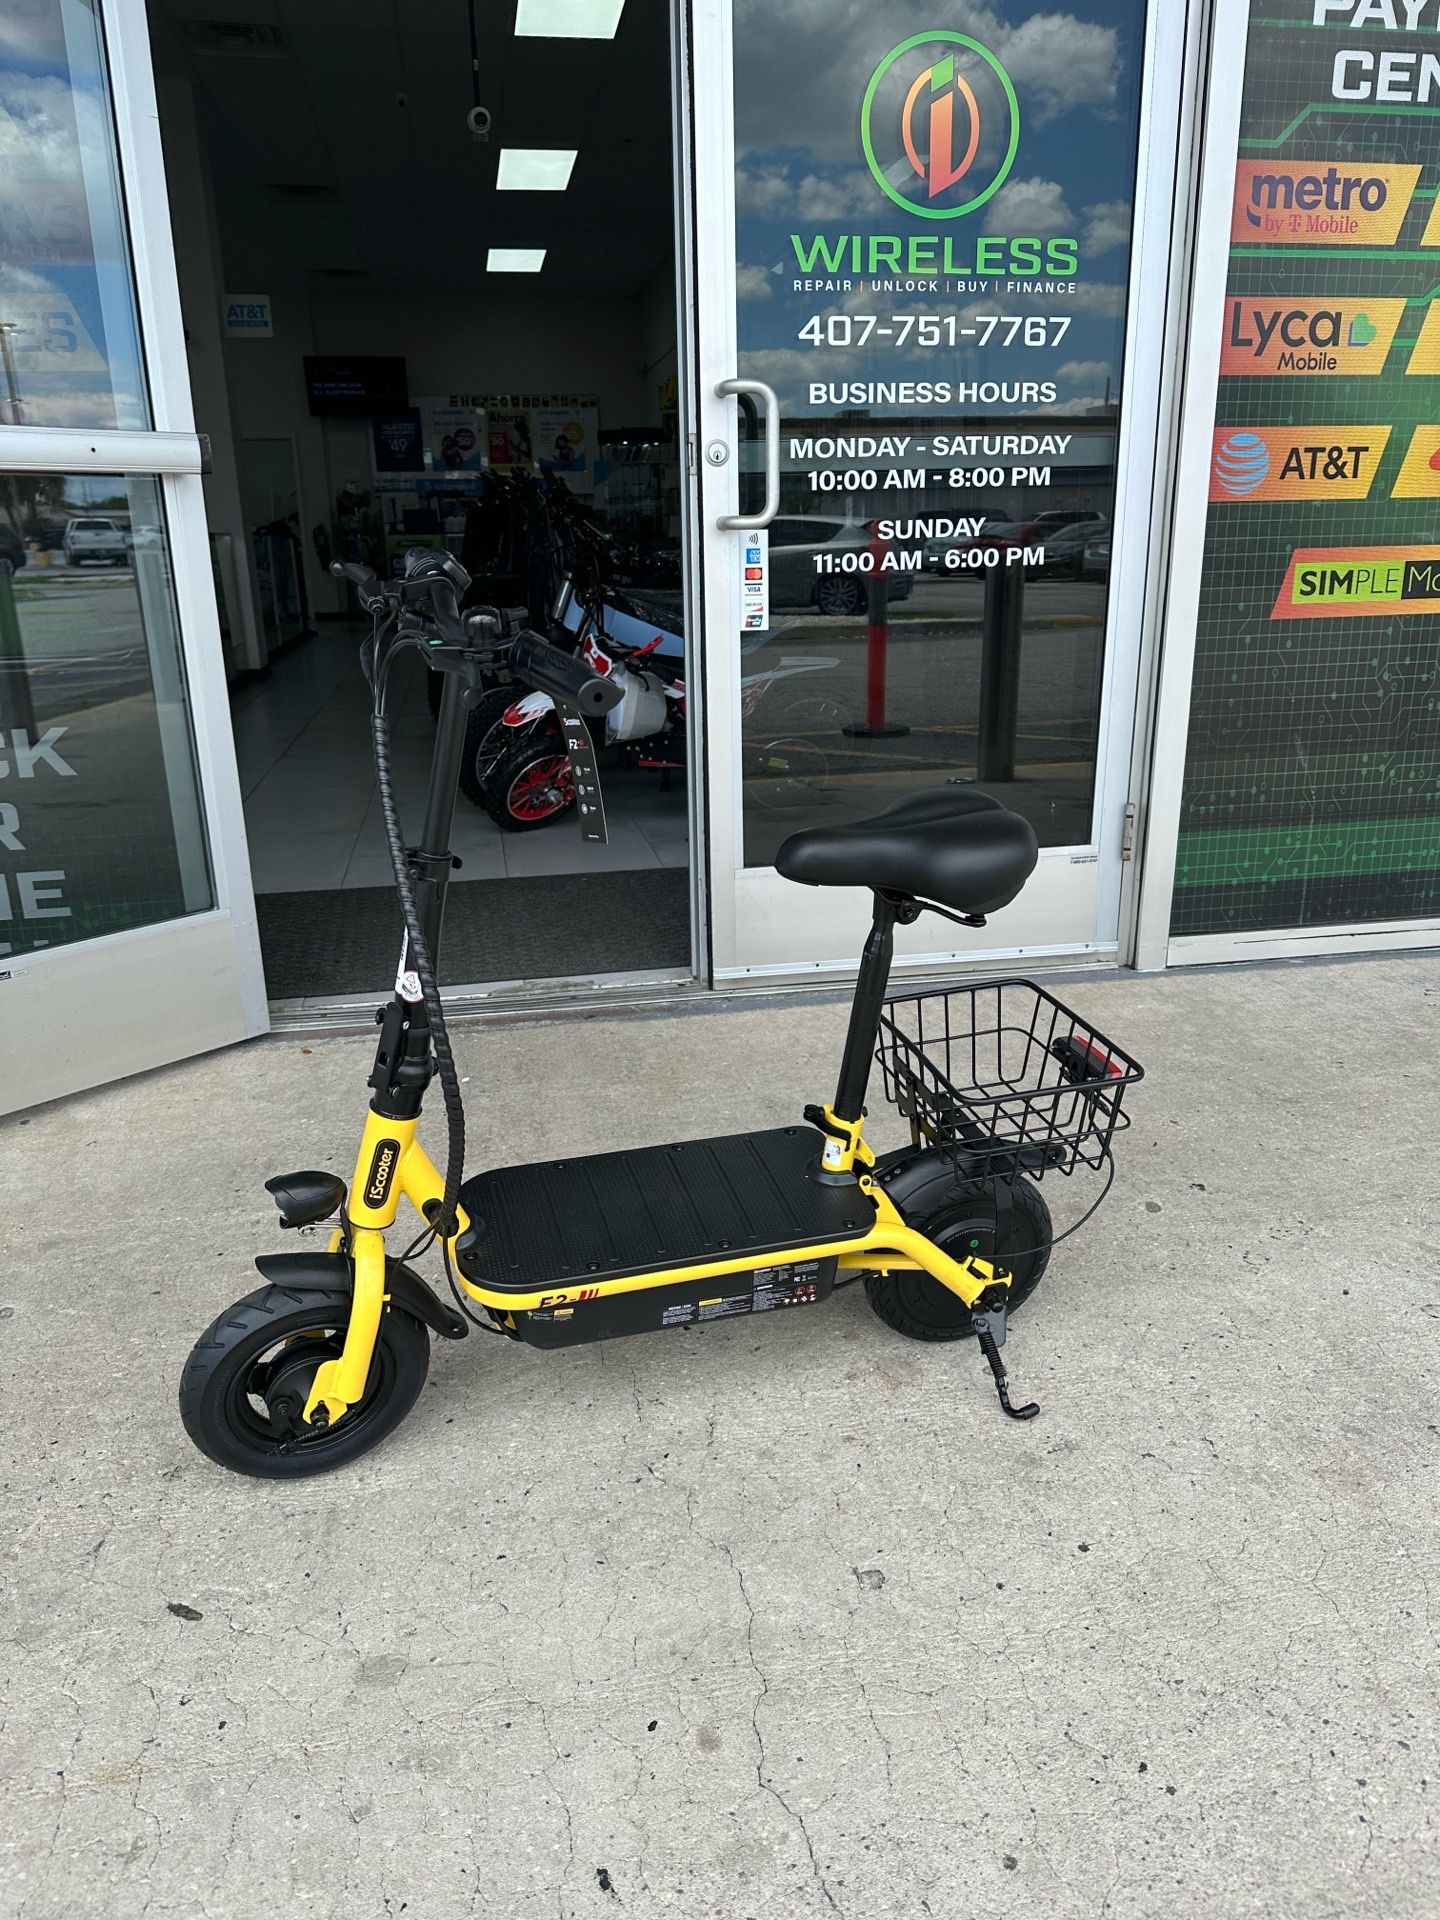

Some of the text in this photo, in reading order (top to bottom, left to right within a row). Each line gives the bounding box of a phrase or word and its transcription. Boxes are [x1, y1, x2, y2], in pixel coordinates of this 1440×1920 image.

[1312, 0, 1440, 31] PAY
[1332, 50, 1440, 102] CEN
[1250, 168, 1389, 213] metro
[1265, 213, 1283, 236] by
[1305, 214, 1358, 234] Mobile
[790, 234, 1078, 276] WIRELESS
[793, 280, 852, 291] REPAIR
[871, 280, 938, 292] UNLOCK
[957, 281, 989, 293] BUY
[1007, 281, 1076, 294] FINANCE
[228, 304, 268, 318] AT&T
[797, 315, 1072, 347] 407-751-7767
[1230, 302, 1343, 357] Lyca
[1277, 352, 1337, 371] Mobile
[809, 381, 1057, 405] BUSINESS HOURS
[789, 436, 911, 459] MONDAY
[932, 434, 1072, 456] SATURDAY
[808, 469, 877, 491] 10:00
[883, 468, 925, 489] AM
[949, 467, 1005, 488] 8:00
[1011, 466, 1051, 487] PM
[1279, 446, 1370, 481] AT&T
[877, 516, 986, 540] SUNDAY
[812, 552, 875, 573] 11:00
[881, 551, 922, 571] AM
[945, 549, 999, 569] 6:00
[1006, 547, 1045, 567] PM
[1299, 567, 1401, 596] SIMPLE
[0, 726, 78, 779] K
[0, 869, 72, 921] E
[369, 1148, 394, 1199] iScooter
